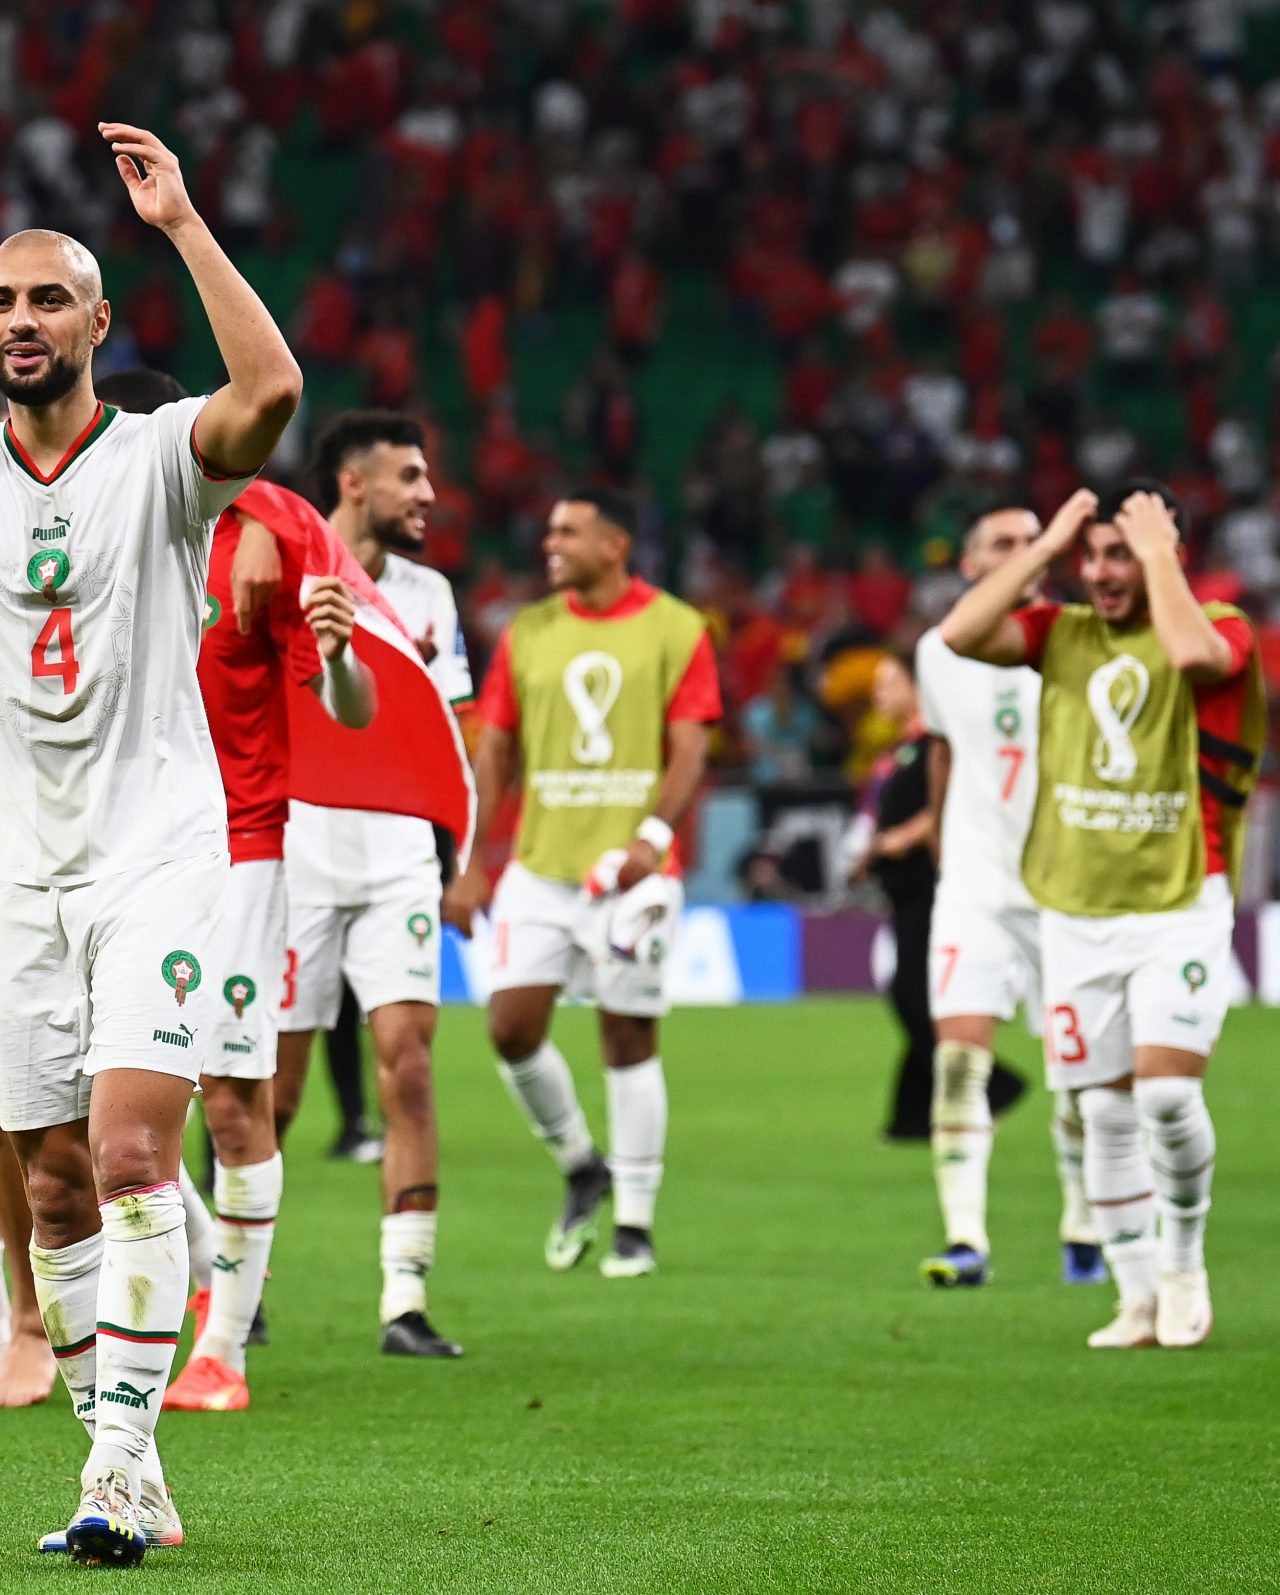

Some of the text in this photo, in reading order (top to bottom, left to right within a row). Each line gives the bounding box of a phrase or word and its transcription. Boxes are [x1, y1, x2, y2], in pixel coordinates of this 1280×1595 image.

[32, 525, 67, 541] PUMA
[31, 607, 81, 695] 4
[998, 746, 1025, 801] 7
[938, 945, 960, 996] 7
[153, 1029, 189, 1048] PUMA
[77, 1400, 96, 1415] PU
[100, 1391, 141, 1409] PUMA
